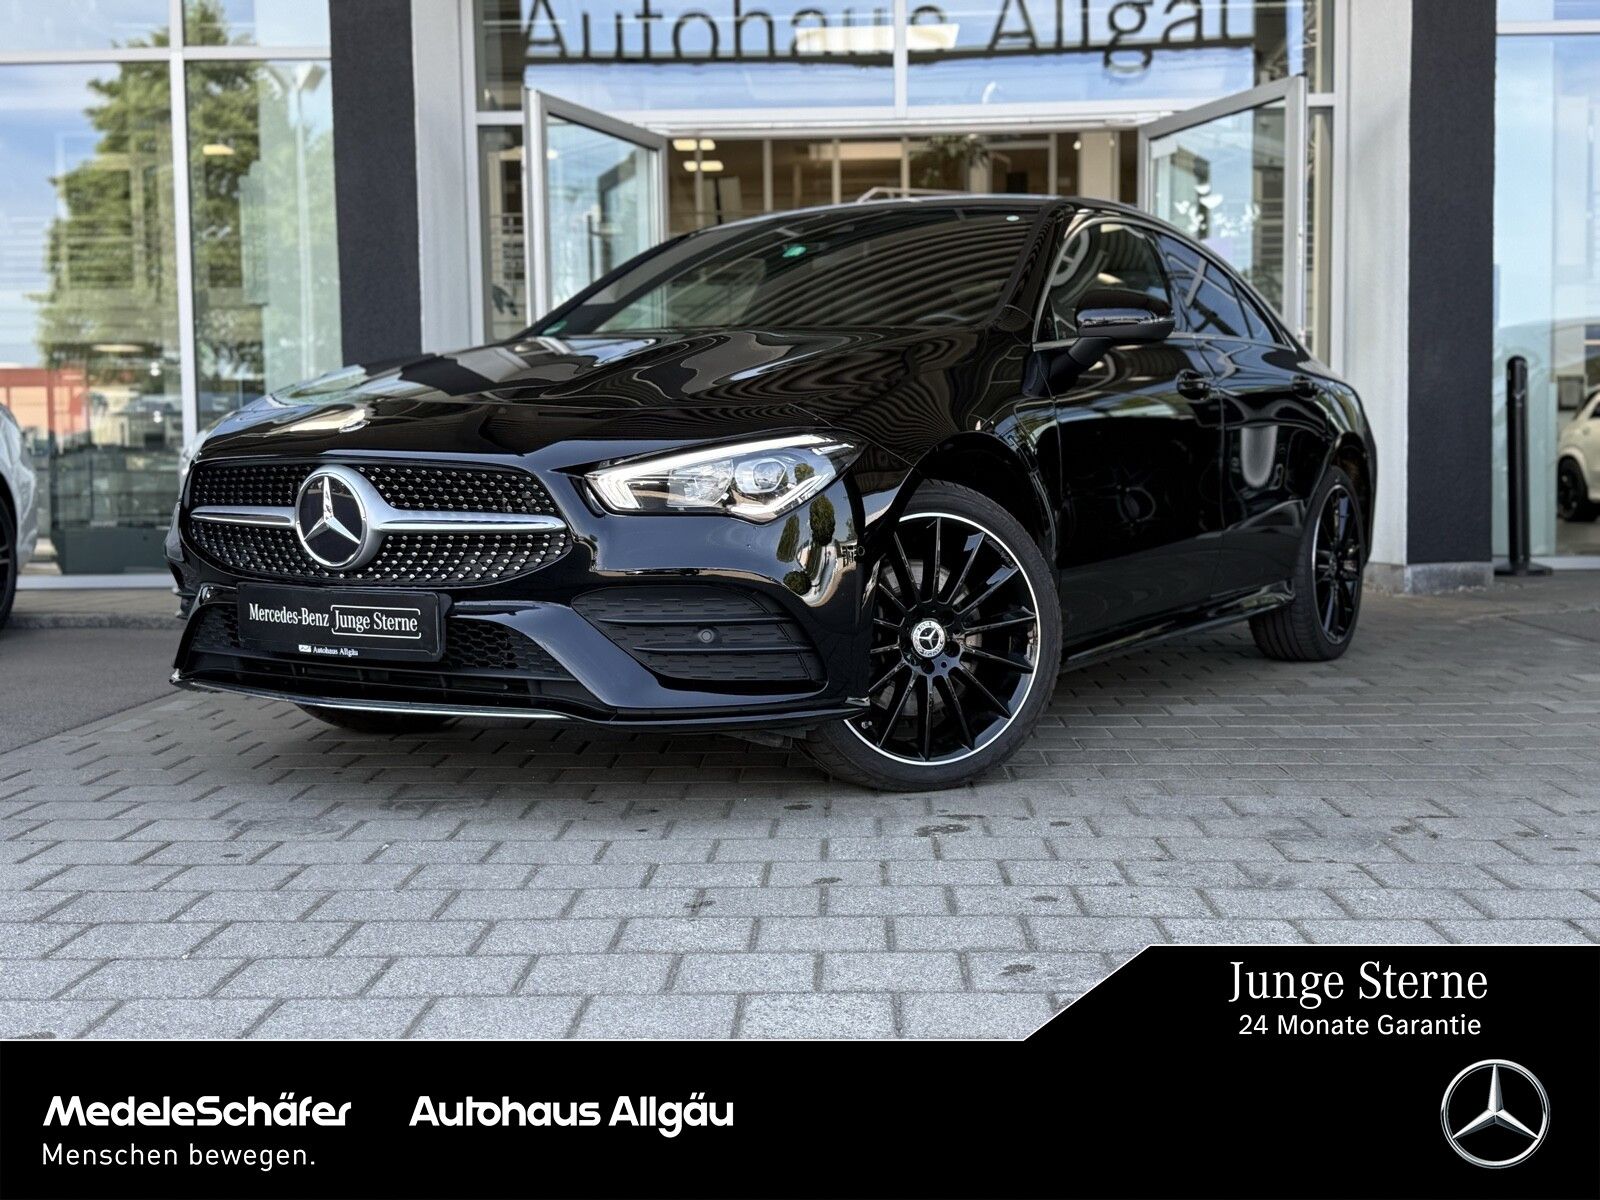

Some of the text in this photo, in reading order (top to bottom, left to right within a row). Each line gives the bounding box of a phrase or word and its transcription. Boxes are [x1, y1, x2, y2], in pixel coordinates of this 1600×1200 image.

[249, 602, 418, 633] Mercedes-Benz Junge Sterne
